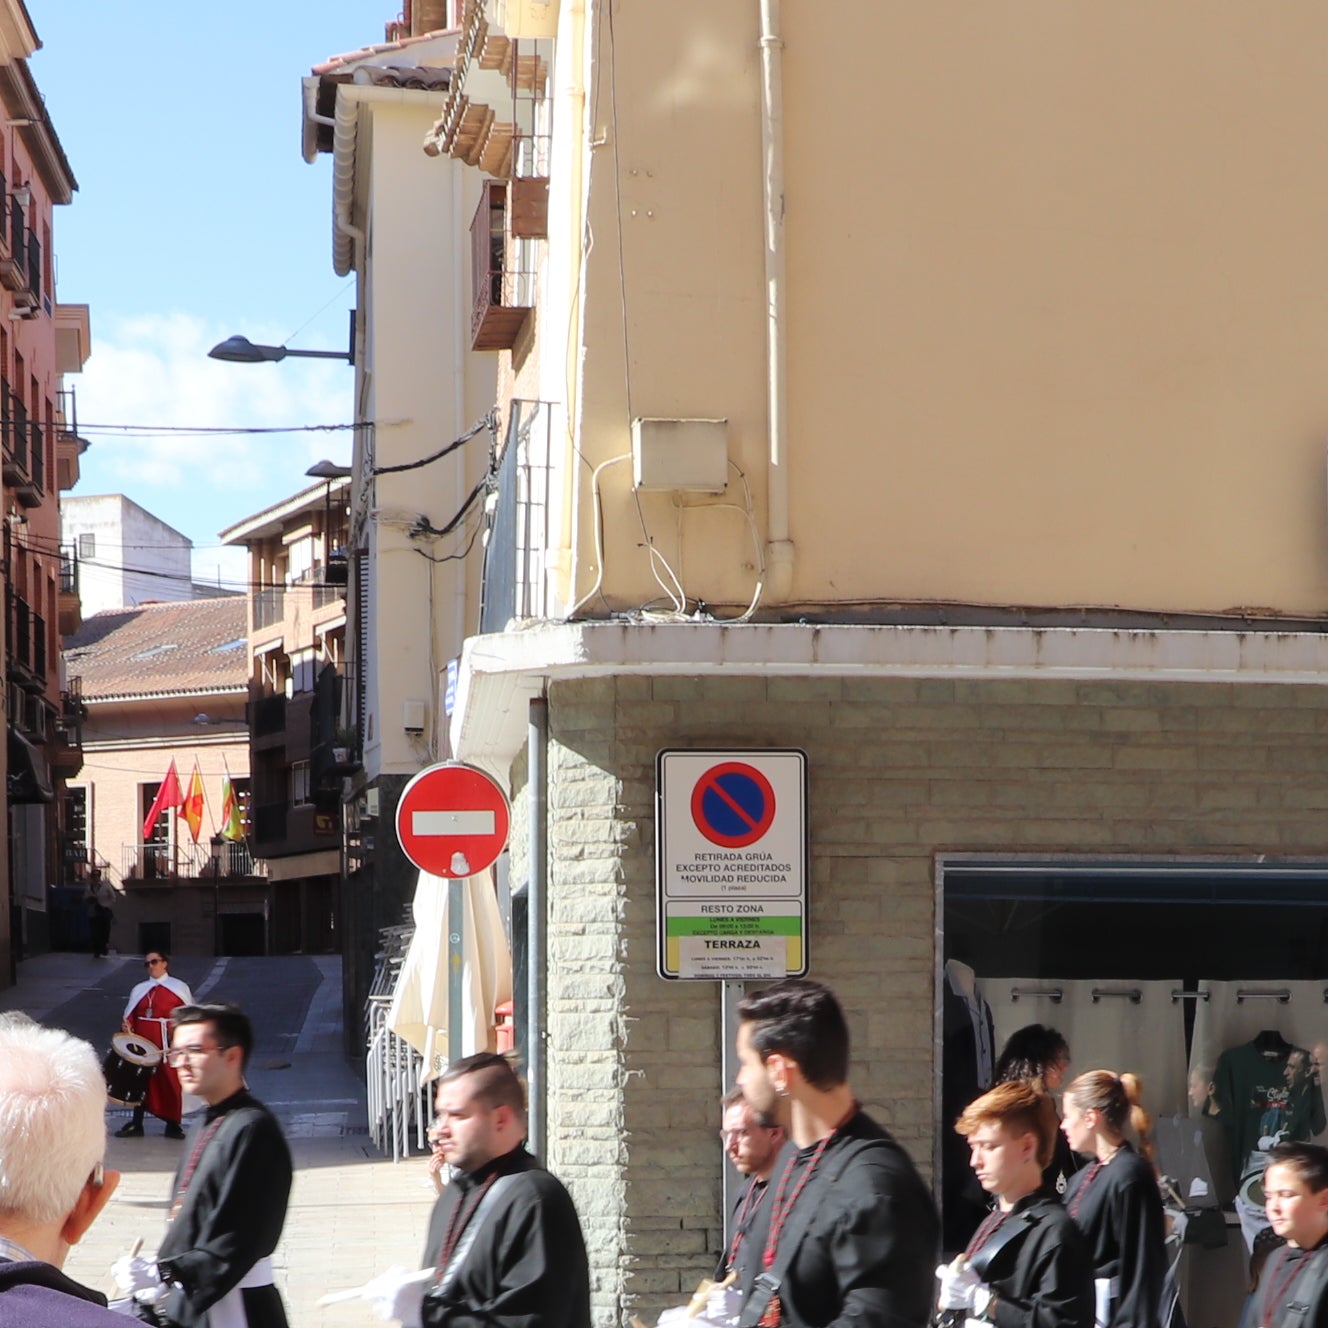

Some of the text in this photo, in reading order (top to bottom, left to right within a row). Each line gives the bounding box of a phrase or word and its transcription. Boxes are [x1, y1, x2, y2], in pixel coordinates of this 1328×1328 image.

[694, 851, 773, 861] RETIRADA GRÚA
[676, 864, 792, 872] EXCEPTO ACREDITADOS
[681, 875, 787, 883] MOVILIDAD REDUCIDA
[701, 905, 764, 913] RESTO ZONA
[704, 940, 761, 949] TERRAZA
